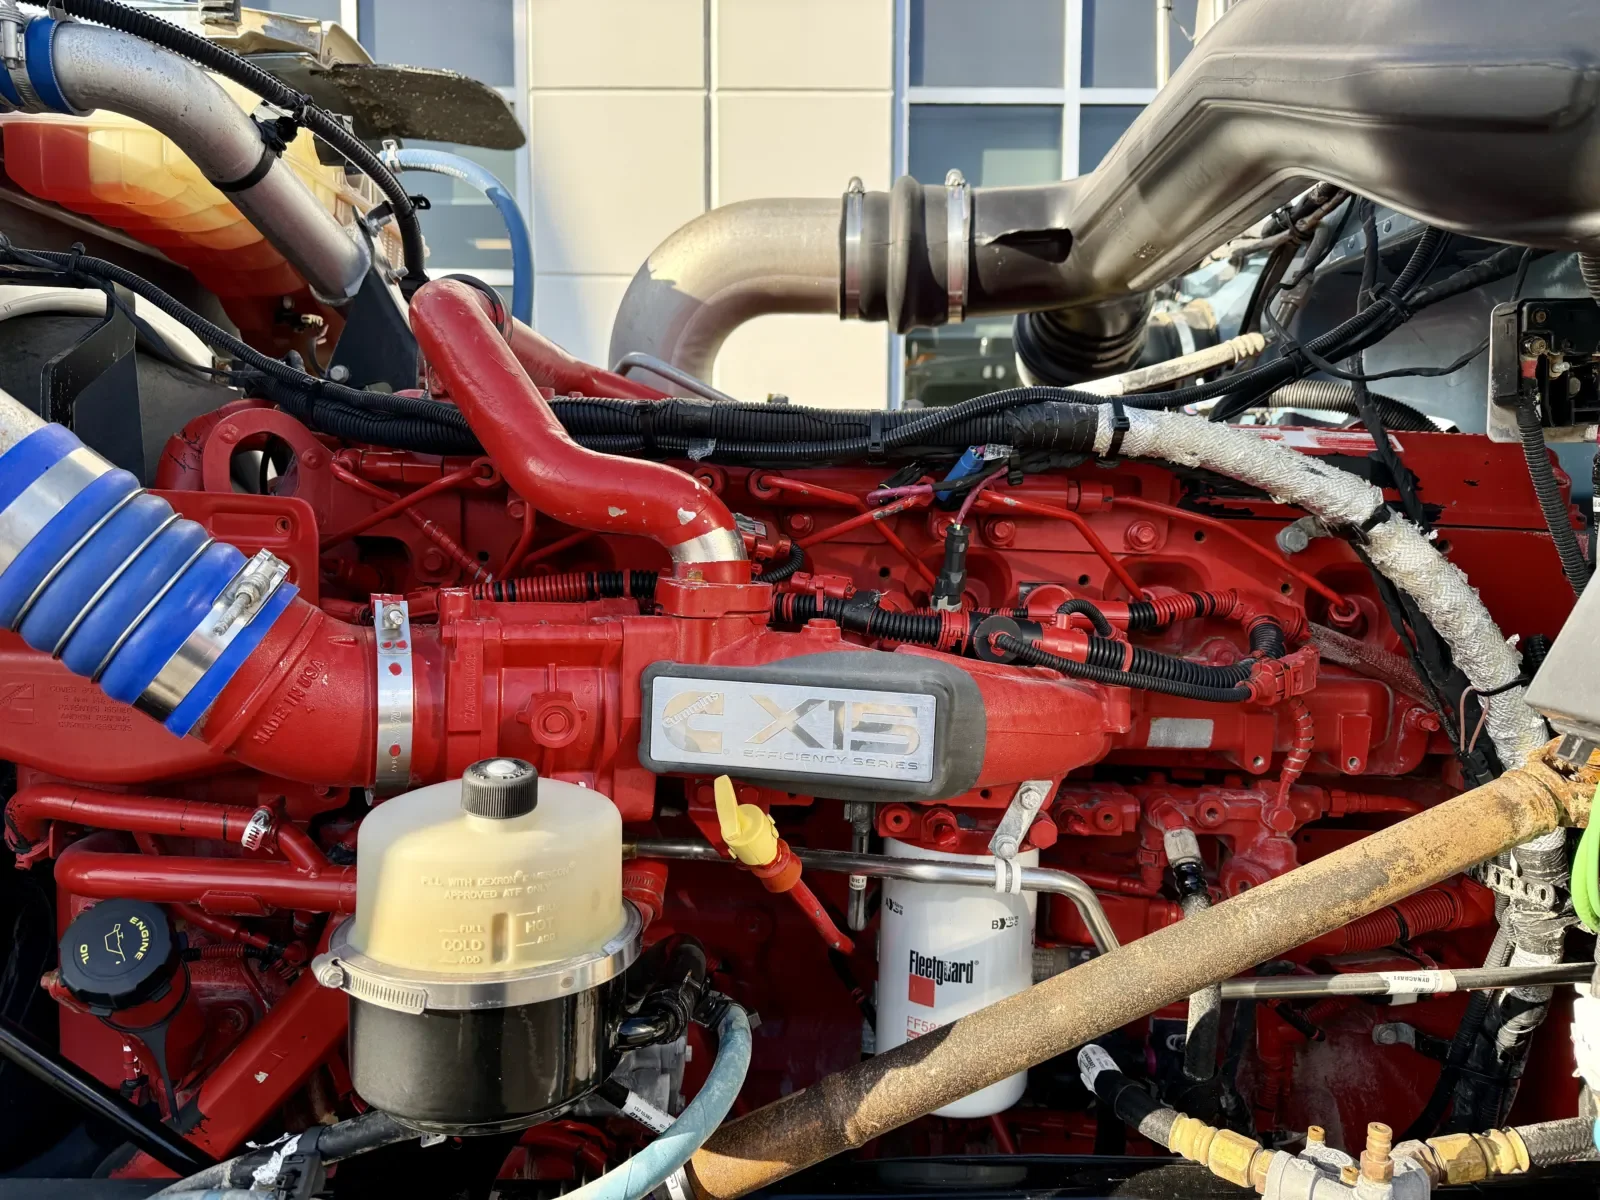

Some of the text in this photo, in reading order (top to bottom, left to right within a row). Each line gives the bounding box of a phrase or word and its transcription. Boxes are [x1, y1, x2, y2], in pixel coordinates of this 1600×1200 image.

[252, 659, 325, 745] MADE IN USA
[744, 694, 921, 755] X15
[743, 749, 918, 770] EFFICIENCY SERIES
[443, 881, 551, 901] APPROVED ATF ONLY
[449, 877, 473, 888] WITH
[477, 875, 516, 886] DEXRON
[459, 924, 484, 933] FULL
[525, 916, 555, 934] HOT
[129, 916, 150, 961] ENGINE
[441, 938, 484, 952] COLD
[537, 932, 556, 944] ADD
[80, 944, 90, 965] OIL
[459, 956, 482, 964] ADD
[909, 949, 974, 986] Fleetguard
